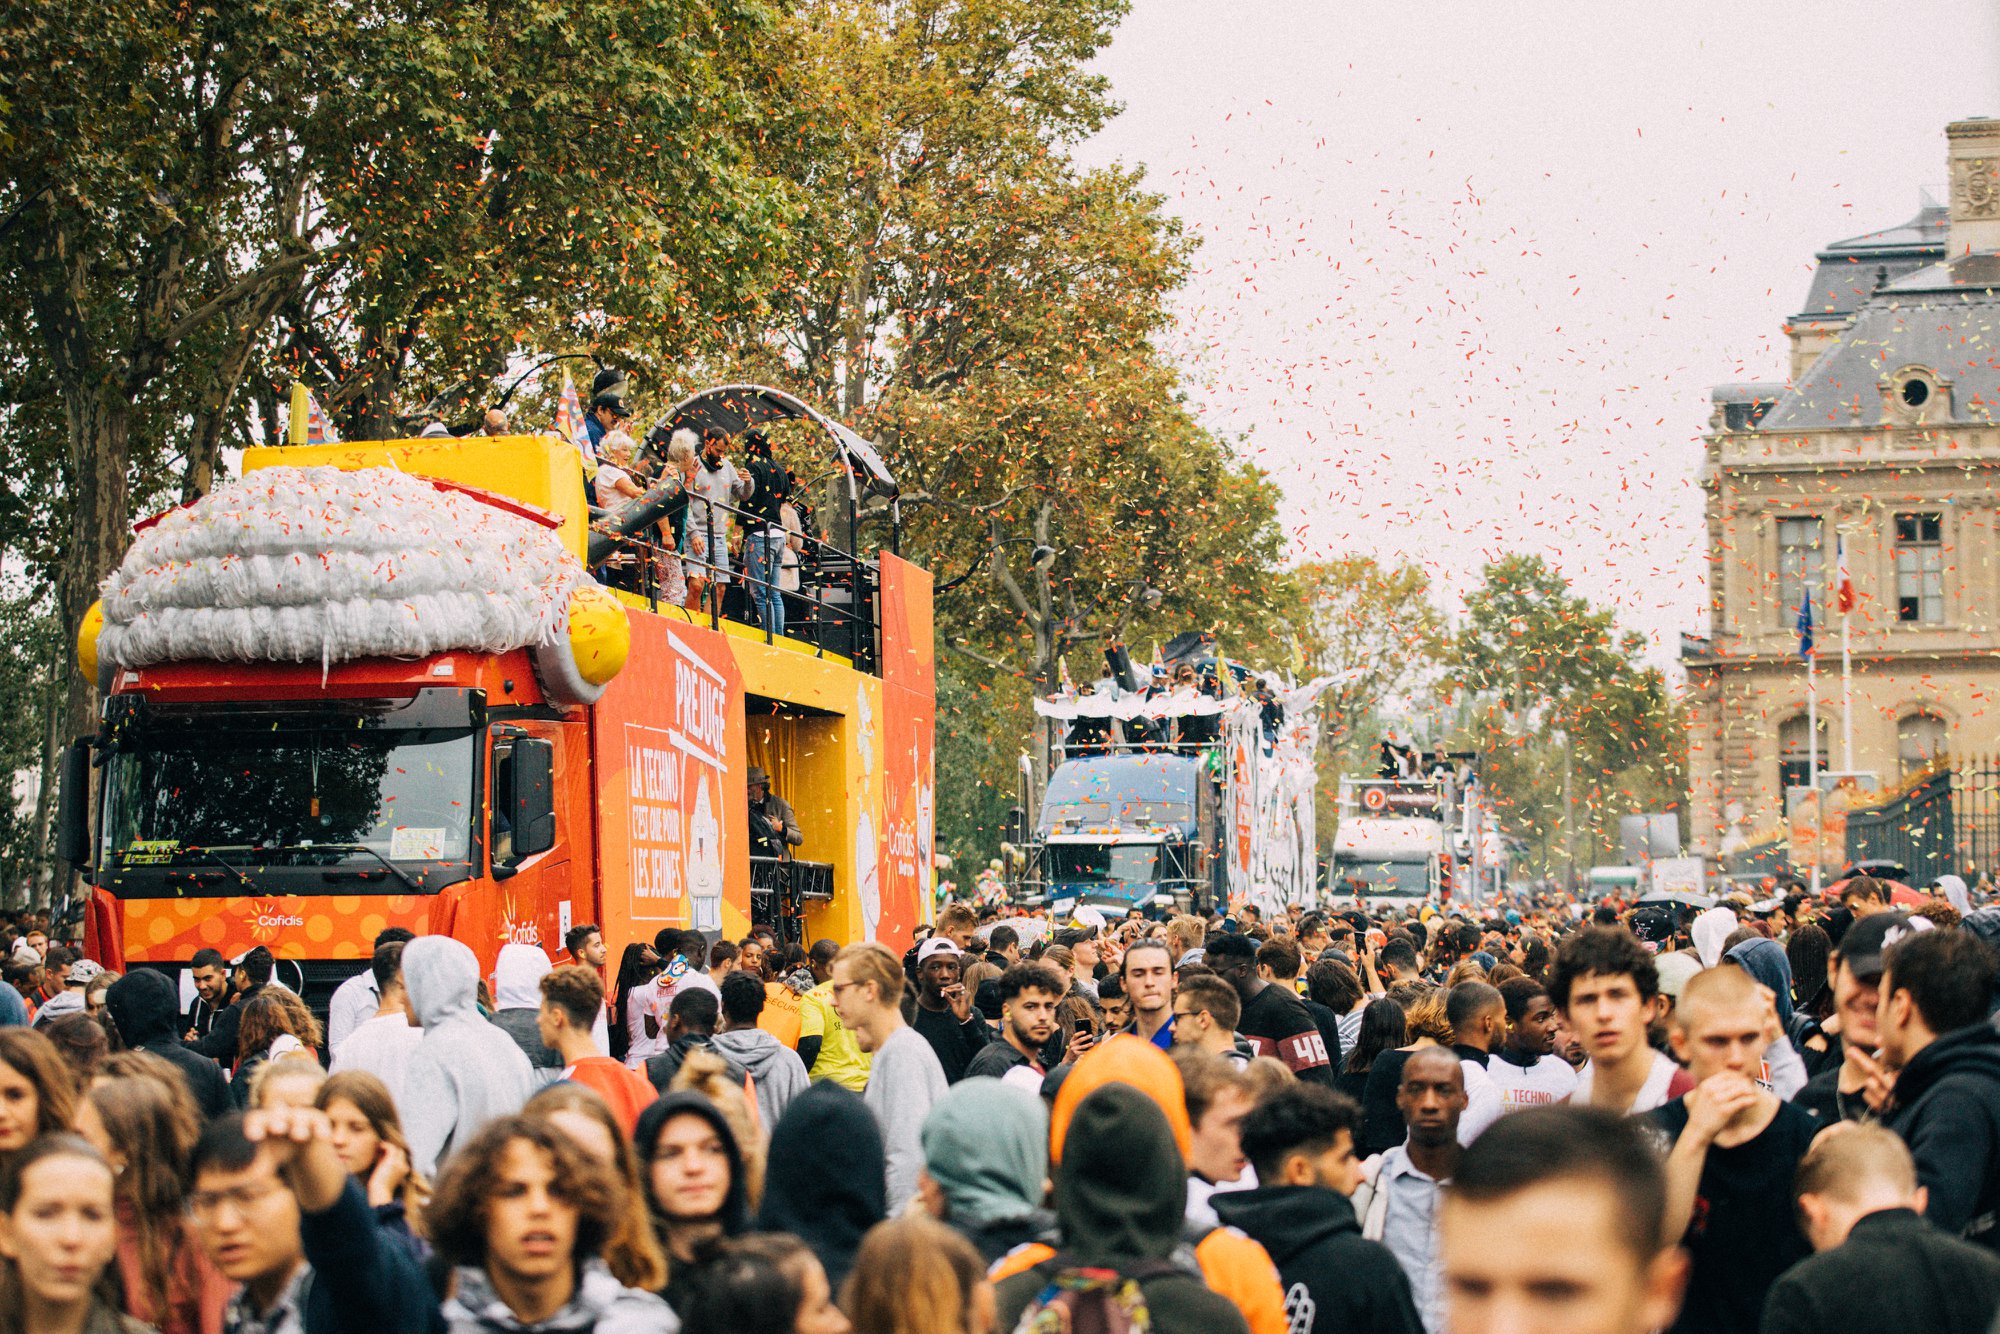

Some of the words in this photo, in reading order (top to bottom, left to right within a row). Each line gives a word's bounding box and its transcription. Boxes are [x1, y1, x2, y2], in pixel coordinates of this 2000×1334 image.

[630, 745, 643, 798] LA
[643, 747, 678, 803] TECHNO
[632, 804, 648, 840] C'EST
[650, 806, 662, 842] QUE
[662, 808, 680, 843] POUR
[633, 847, 649, 897] LES
[651, 849, 681, 898] JEUNES
[258, 915, 303, 926] Cofidis
[509, 920, 538, 945] Cofidis
[1513, 1089, 1552, 1104] TECHNO
